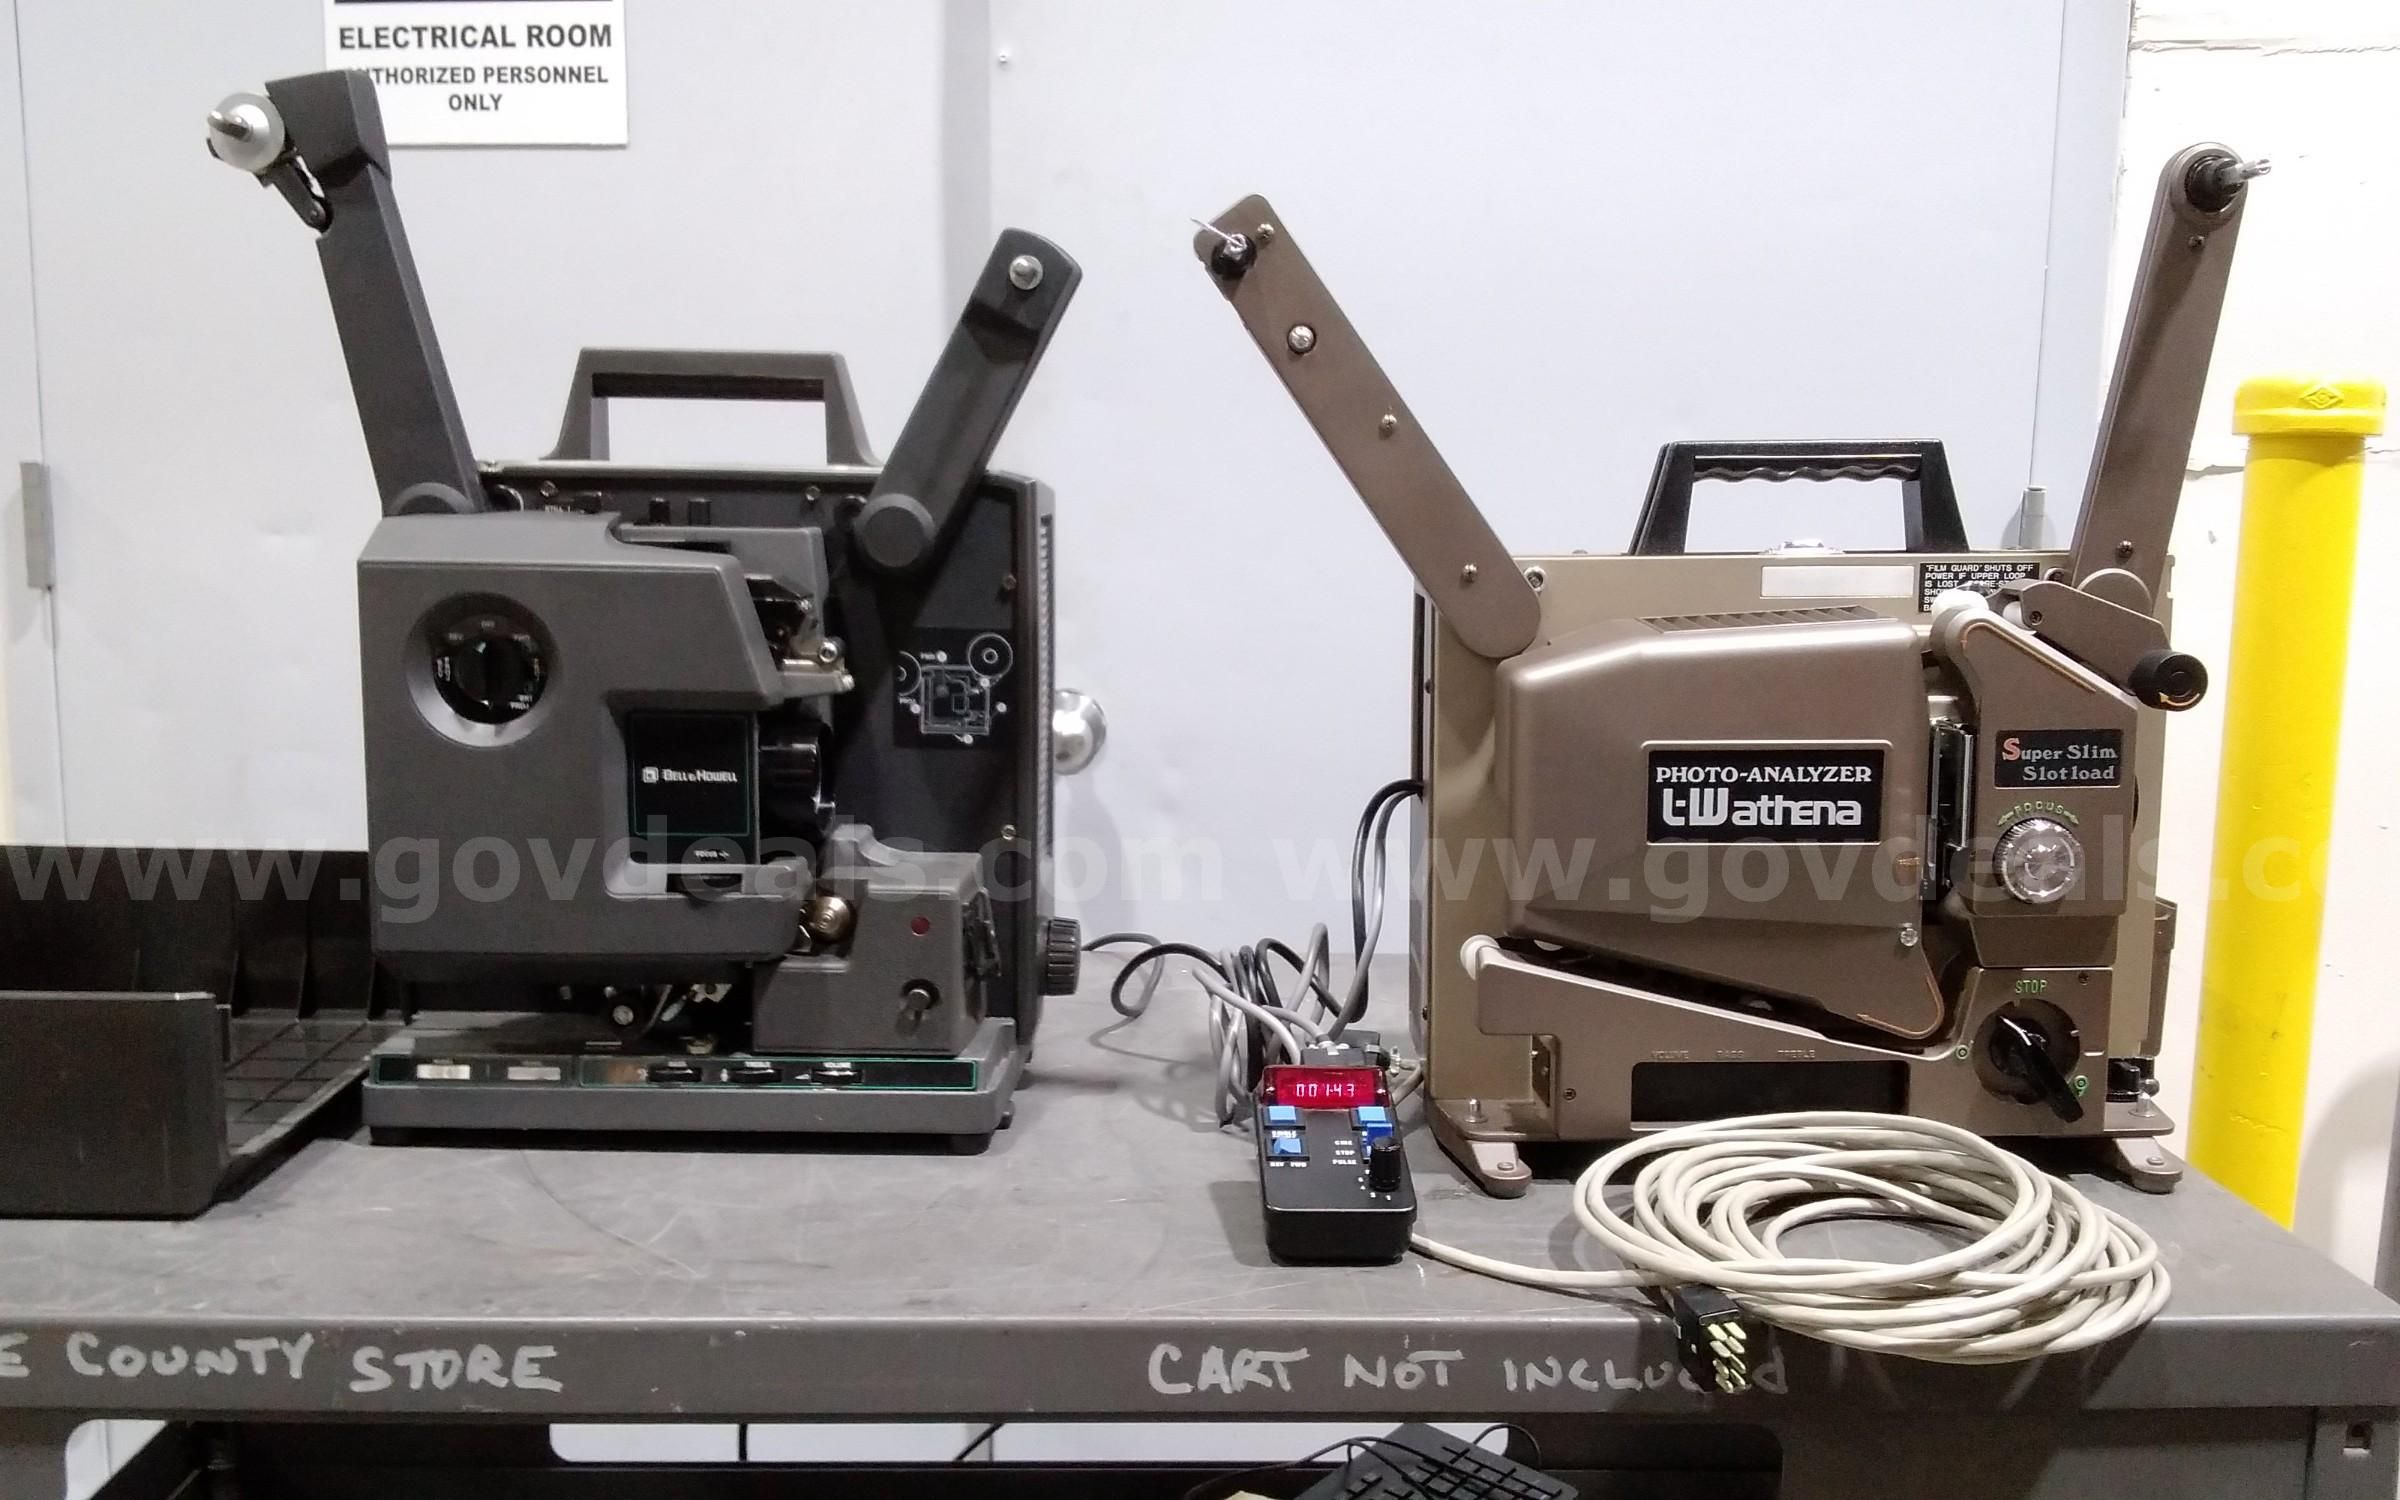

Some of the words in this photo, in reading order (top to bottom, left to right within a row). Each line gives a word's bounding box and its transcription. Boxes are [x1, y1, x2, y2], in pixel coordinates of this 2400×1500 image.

[339, 25, 516, 49] ELECTRICAL
[527, 24, 612, 48] ROOM
[370, 66, 476, 84] THORIZED
[484, 66, 609, 83] PERSONNEL
[448, 94, 503, 111] ONLY
[1924, 572, 1954, 580] POWER
[1958, 572, 1967, 580] IF
[1970, 572, 2000, 580] UPPER
[2003, 572, 2026, 580] LOOP
[1984, 564, 2012, 572] SHUTS
[2016, 564, 2033, 572] OFF
[1924, 580, 1933, 588] IS
[2002, 737, 2064, 763] Super
[2066, 744, 2118, 760] Slim
[1655, 766, 1873, 783] PHOTO-ANALYZER
[2013, 801, 2065, 816] FOCUS
[2015, 979, 2048, 994] STOP
[67, 1331, 313, 1379] COUNTY
[350, 1343, 562, 1392] STORE
[1149, 1343, 1310, 1394] CART
[1344, 1349, 1465, 1390] NOT
